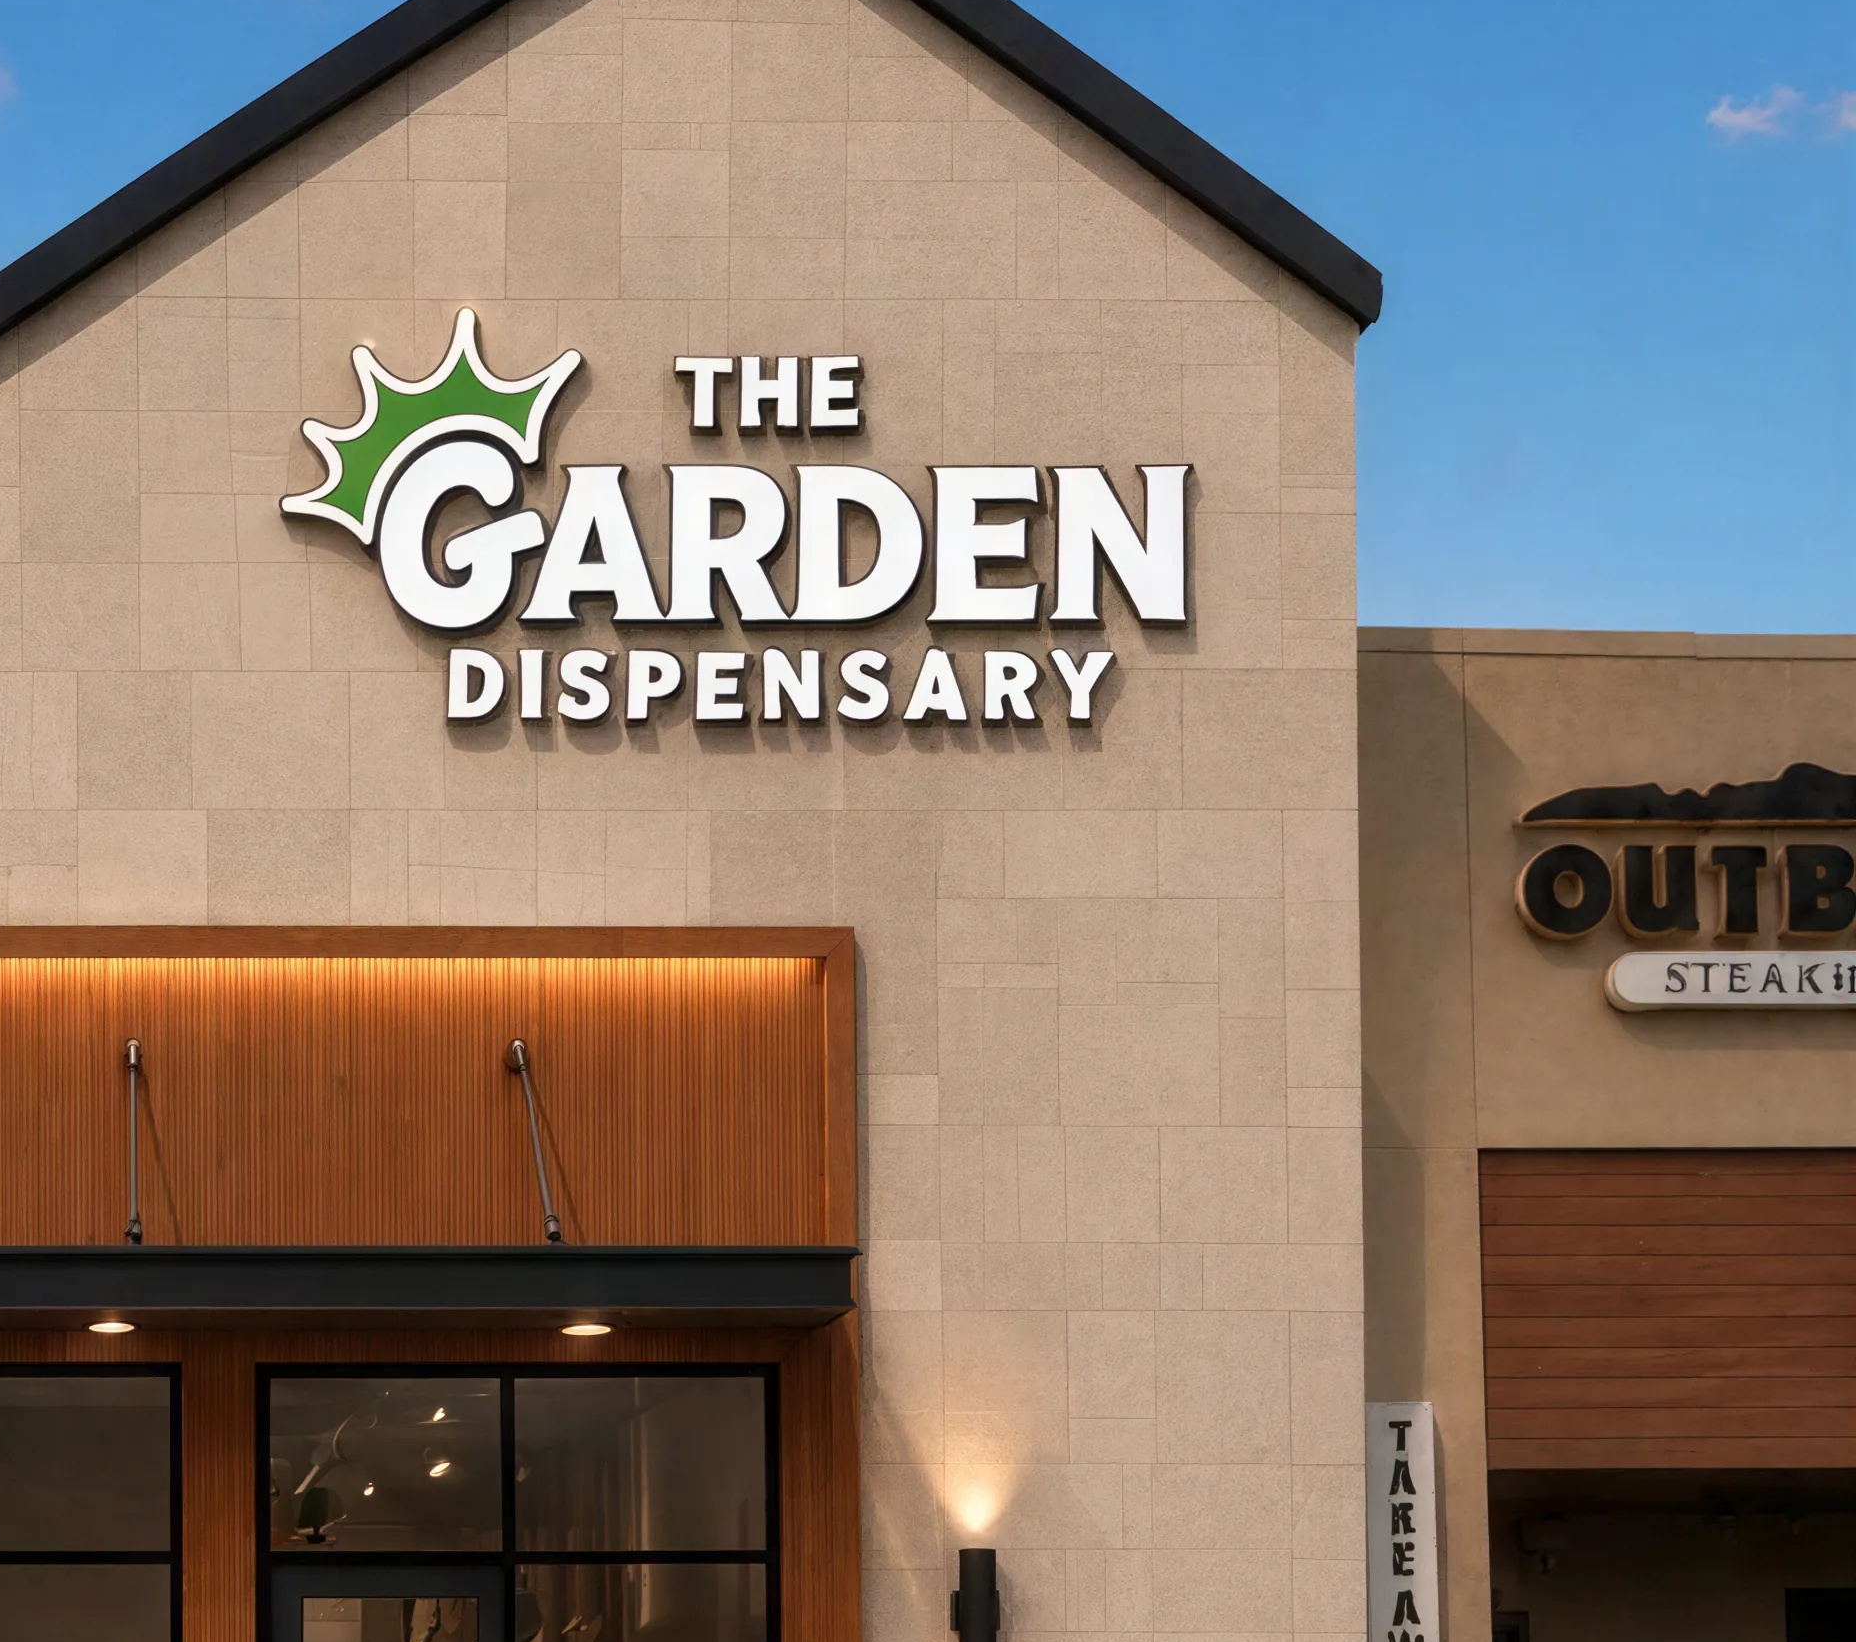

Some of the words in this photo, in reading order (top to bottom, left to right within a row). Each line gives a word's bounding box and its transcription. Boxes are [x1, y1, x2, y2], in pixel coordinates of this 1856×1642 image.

[675, 356, 861, 428] THE
[380, 440, 1189, 629] GARDEN
[448, 648, 1114, 722] DISPENSARY
[1517, 842, 1856, 937] OUTB
